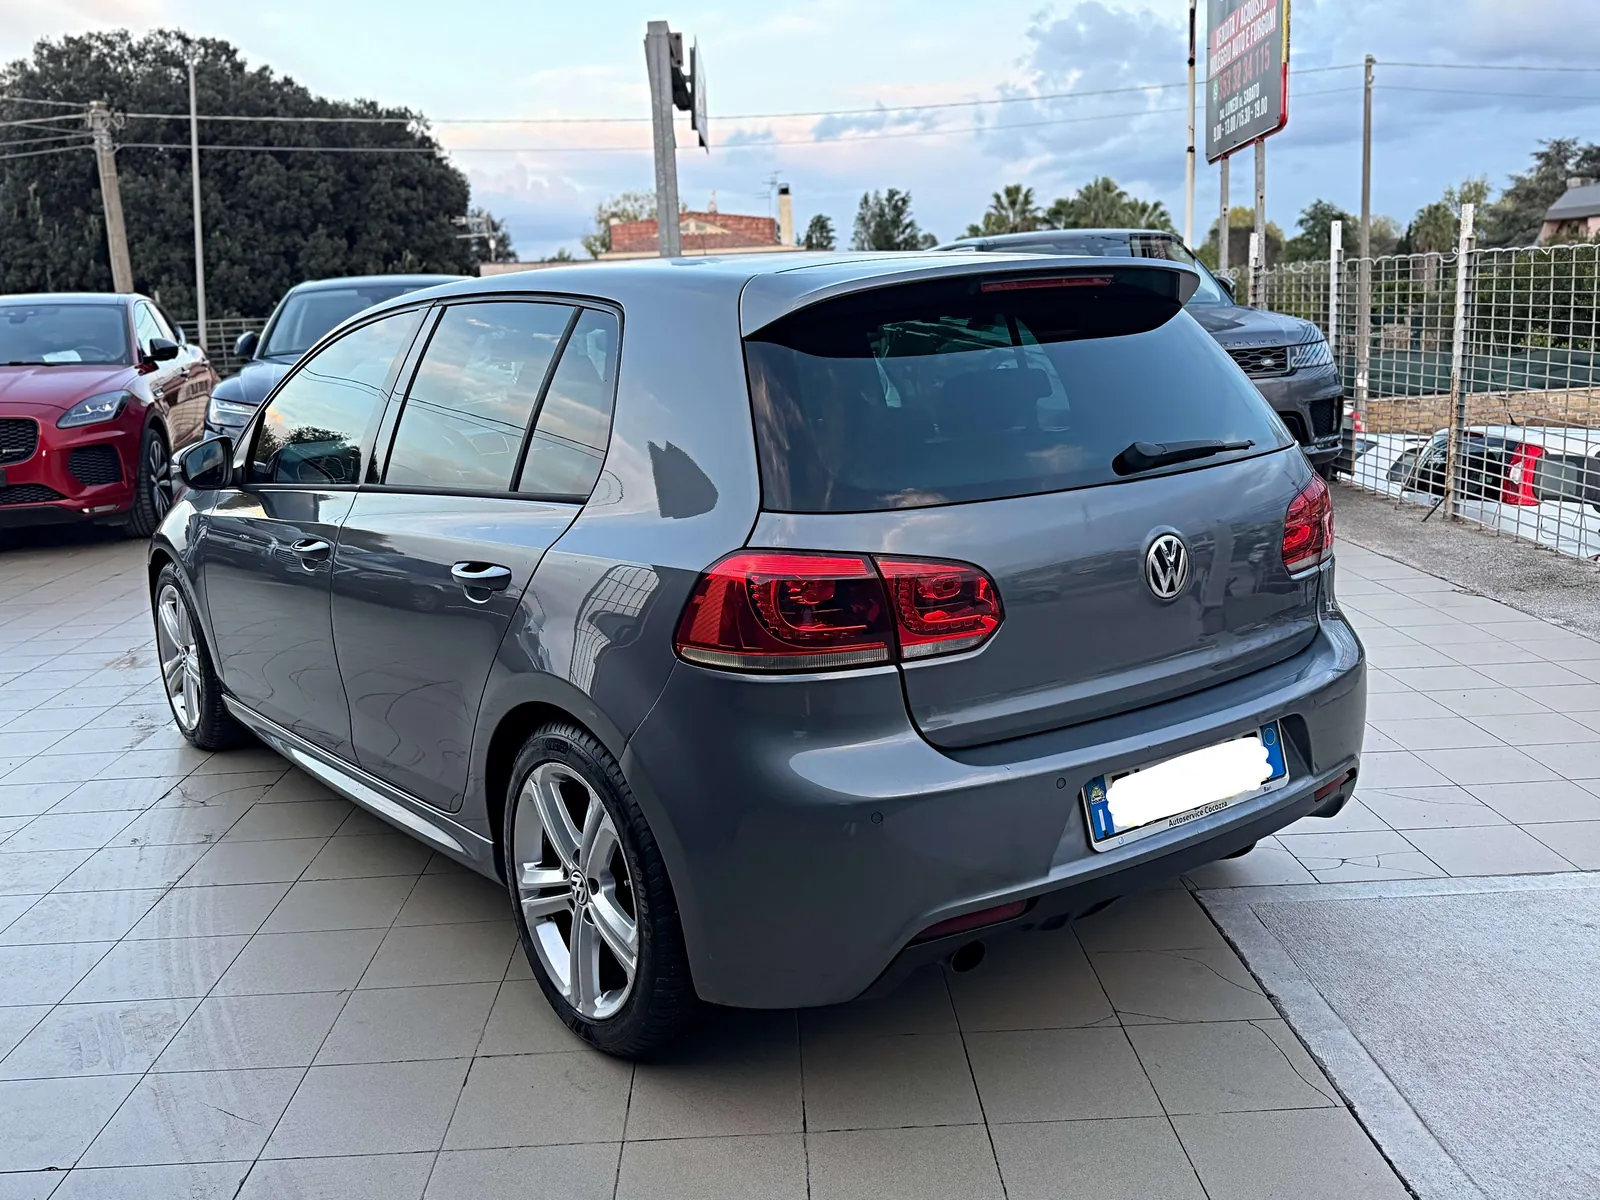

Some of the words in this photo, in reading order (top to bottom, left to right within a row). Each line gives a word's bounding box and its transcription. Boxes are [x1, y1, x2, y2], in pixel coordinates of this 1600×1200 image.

[1246, 26, 1250, 48] E
[1221, 338, 1280, 348] ROVER
[1168, 809, 1204, 827] Autoservice
[1204, 801, 1228, 815] Cocozza
